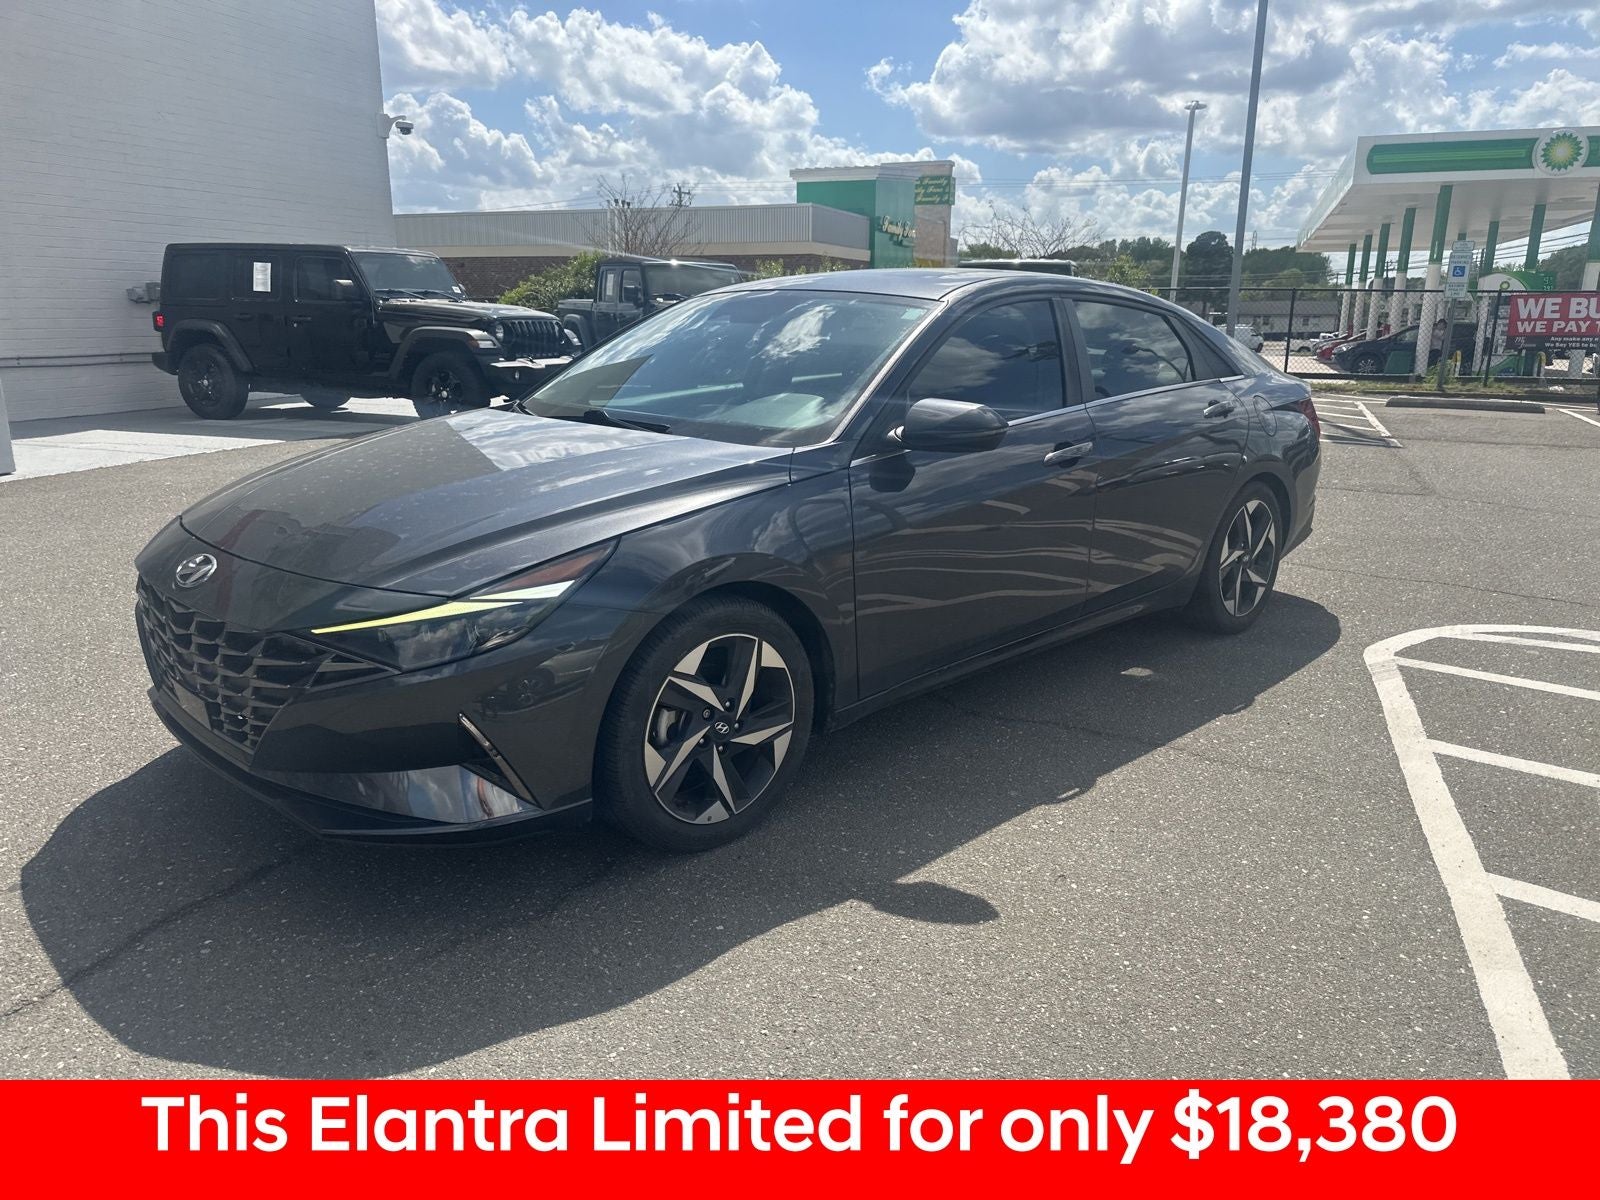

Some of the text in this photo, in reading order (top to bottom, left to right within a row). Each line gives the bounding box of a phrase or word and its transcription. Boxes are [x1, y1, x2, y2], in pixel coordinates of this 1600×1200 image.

[1517, 297, 1562, 319] WE
[1517, 321, 1547, 333] WE
[1552, 321, 1591, 333] PAY
